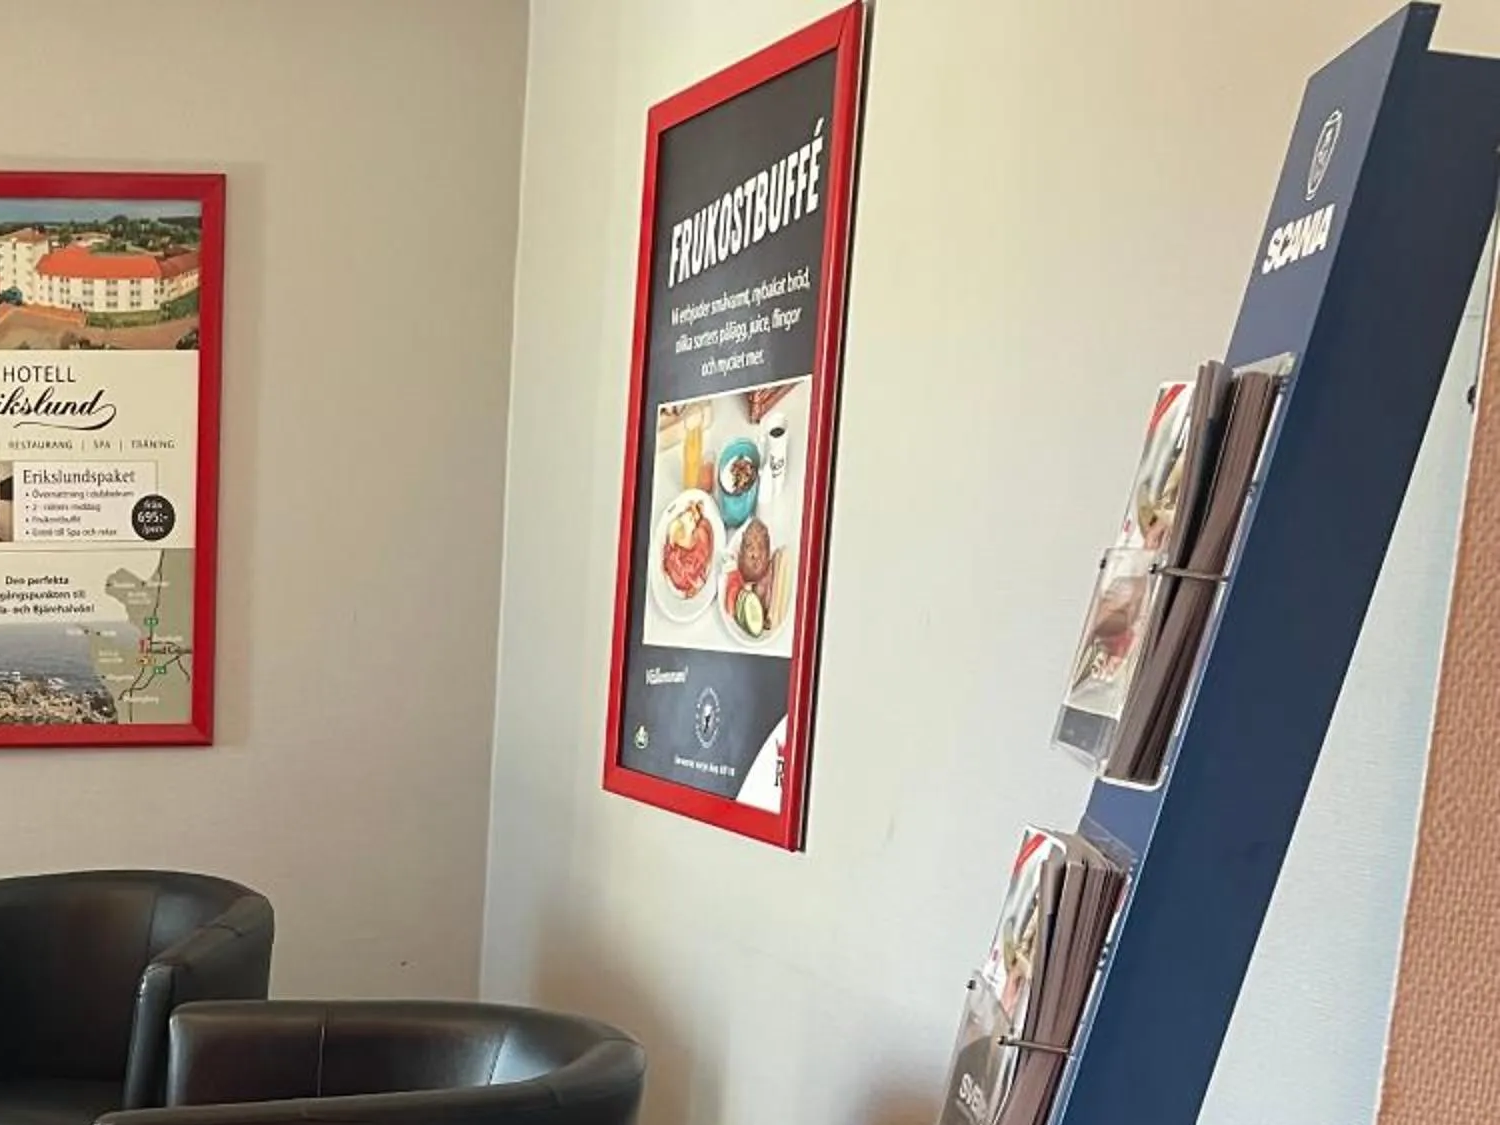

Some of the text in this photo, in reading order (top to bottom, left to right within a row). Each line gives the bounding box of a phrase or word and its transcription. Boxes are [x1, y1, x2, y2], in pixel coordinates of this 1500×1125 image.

[668, 116, 825, 289] FRUKOSTBUFFÉ
[1262, 203, 1336, 275] SCANIA
[3, 365, 76, 383] HOTELL
[8, 440, 73, 450] RESTAURANG
[92, 440, 111, 450] SPA
[130, 438, 176, 450] TRÄNING
[22, 469, 136, 487] Erikslundspaket
[137, 512, 168, 523] 695:-
[5, 575, 69, 586] Den perfekta
